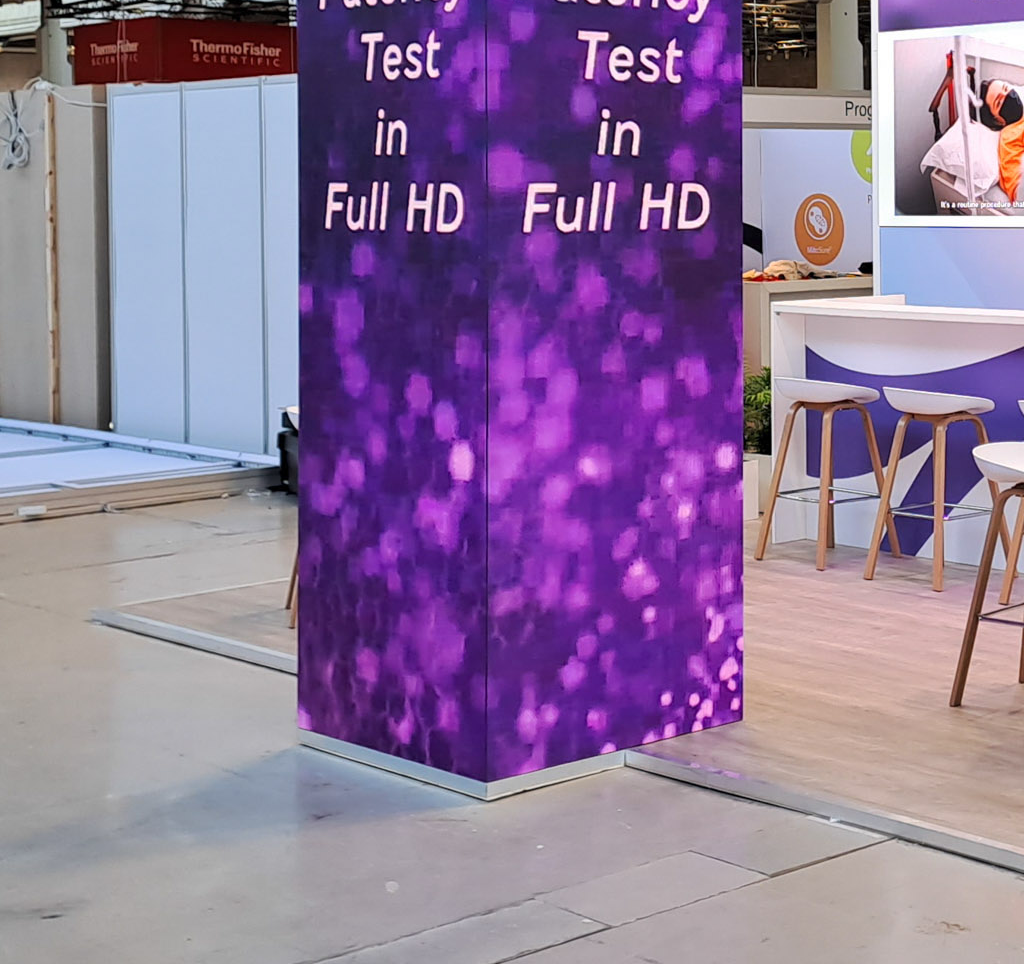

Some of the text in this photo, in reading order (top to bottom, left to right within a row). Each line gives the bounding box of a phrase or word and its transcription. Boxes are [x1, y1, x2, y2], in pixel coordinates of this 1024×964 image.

[192, 54, 281, 67] SCIENTIFIC
[360, 29, 441, 82] Test
[577, 30, 683, 84] Test
[374, 108, 408, 156] in
[597, 108, 642, 157] in
[324, 181, 464, 233] Full HD
[522, 181, 711, 234] Full HD
[957, 200, 979, 209] routine
[980, 200, 1012, 210] procedure
